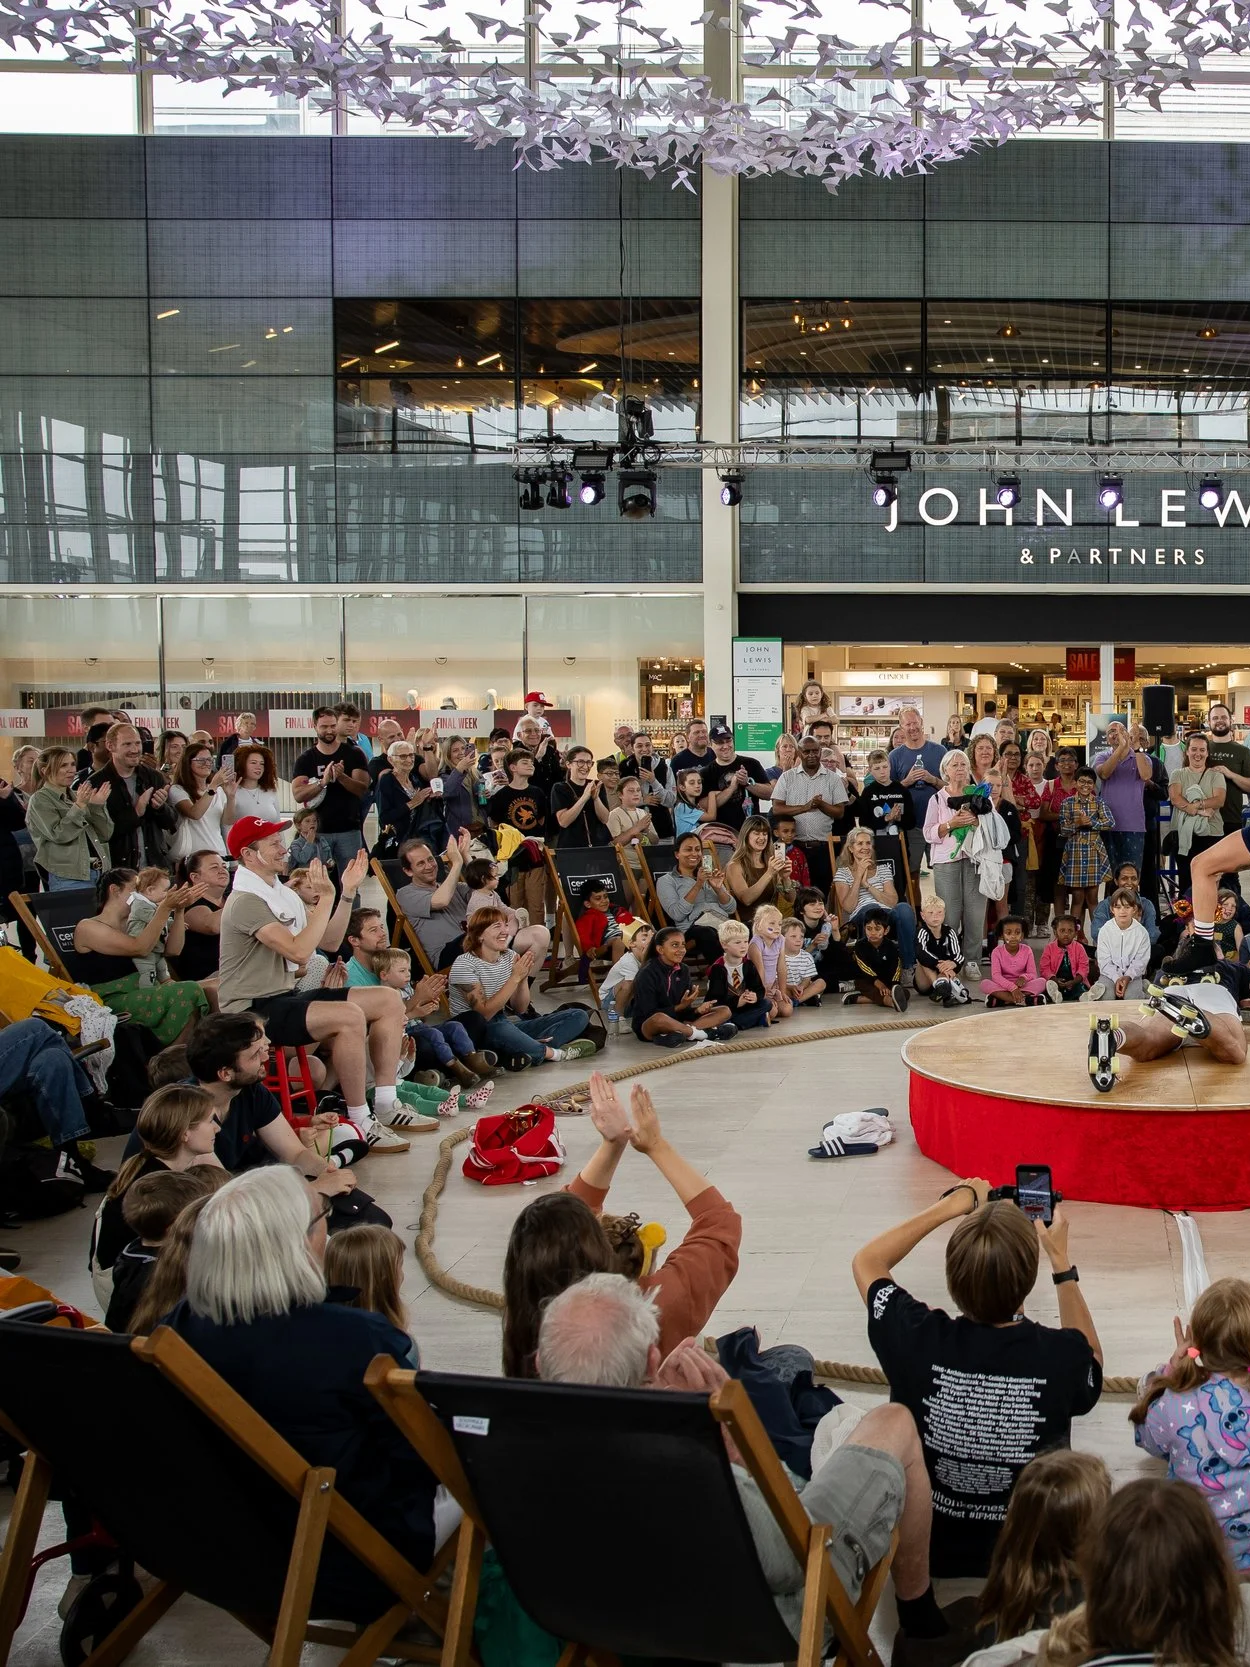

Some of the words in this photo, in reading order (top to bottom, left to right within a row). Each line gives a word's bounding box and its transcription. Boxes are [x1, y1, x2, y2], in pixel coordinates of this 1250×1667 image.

[885, 488, 1073, 532] JOHN
[1020, 548, 1034, 565] &
[1051, 548, 1205, 565] PARTNERS
[1070, 654, 1097, 672] SALE
[9, 717, 29, 729] WEEK
[67, 715, 82, 733] SA
[134, 717, 156, 728] FINAL
[285, 717, 306, 729] FINAL
[436, 717, 456, 729] FINAL
[457, 717, 478, 729] WEEK
[928, 1395, 940, 1404] Lucy
[944, 1419, 960, 1427] Diesel
[963, 1423, 992, 1431] Roachford
[946, 1426, 966, 1434] Theatre
[963, 1441, 999, 1450] Shakespeare
[932, 1490, 1007, 1512] iltonkeynes.
[969, 1511, 1007, 1520] #IFMKfe
